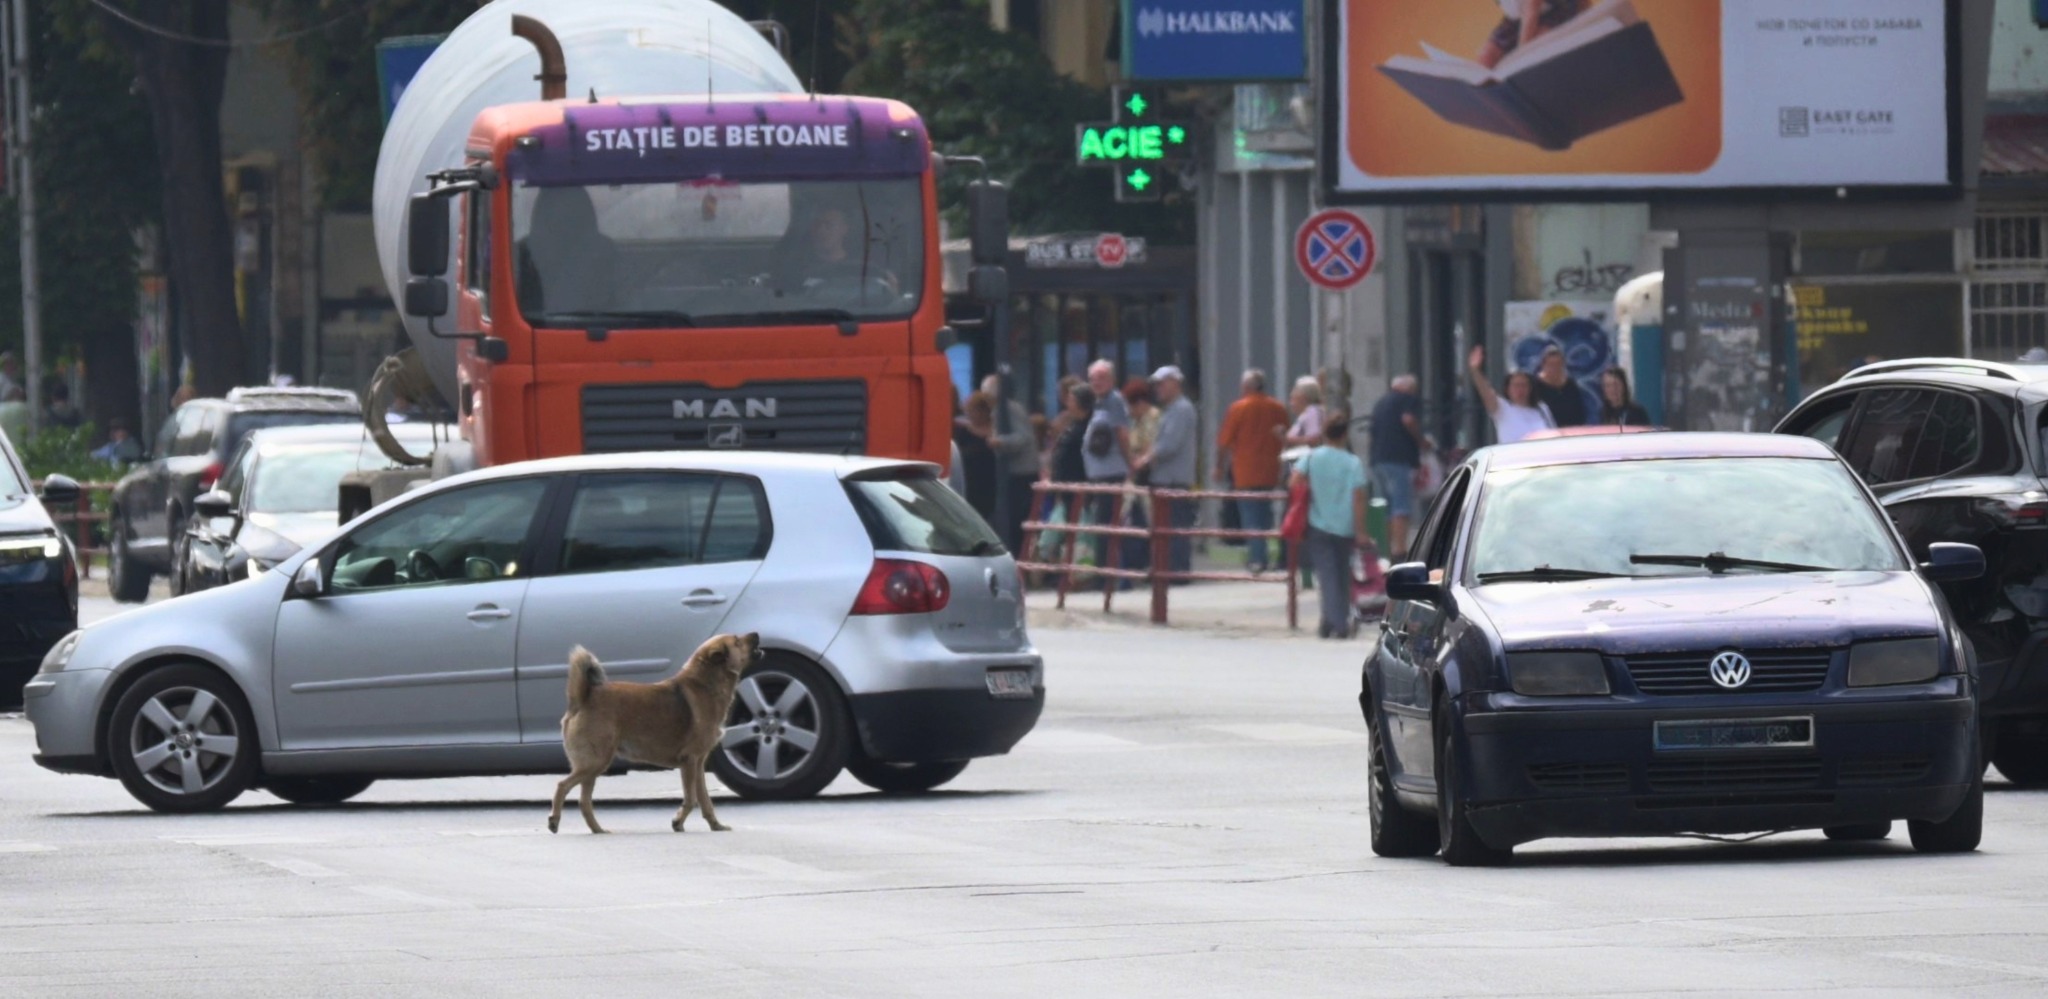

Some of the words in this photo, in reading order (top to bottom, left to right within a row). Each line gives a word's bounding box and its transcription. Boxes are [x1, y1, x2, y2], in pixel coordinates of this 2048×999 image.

[1167, 10, 1295, 33] HALKBANK
[1757, 19, 1785, 31] НОВ
[1788, 19, 1846, 31] ПОЧЕТОК
[1851, 19, 1870, 30] СО
[1873, 18, 1923, 30] ЗАБАВА
[1803, 35, 1813, 47] И
[1815, 34, 1878, 47] ПОПУСТИ
[1813, 109, 1852, 124] EAST
[1856, 109, 1894, 124] GATE
[683, 125, 718, 147] DE
[725, 124, 848, 147] BETOANE
[1028, 243, 1065, 259] BUS
[672, 397, 777, 418] MAN
